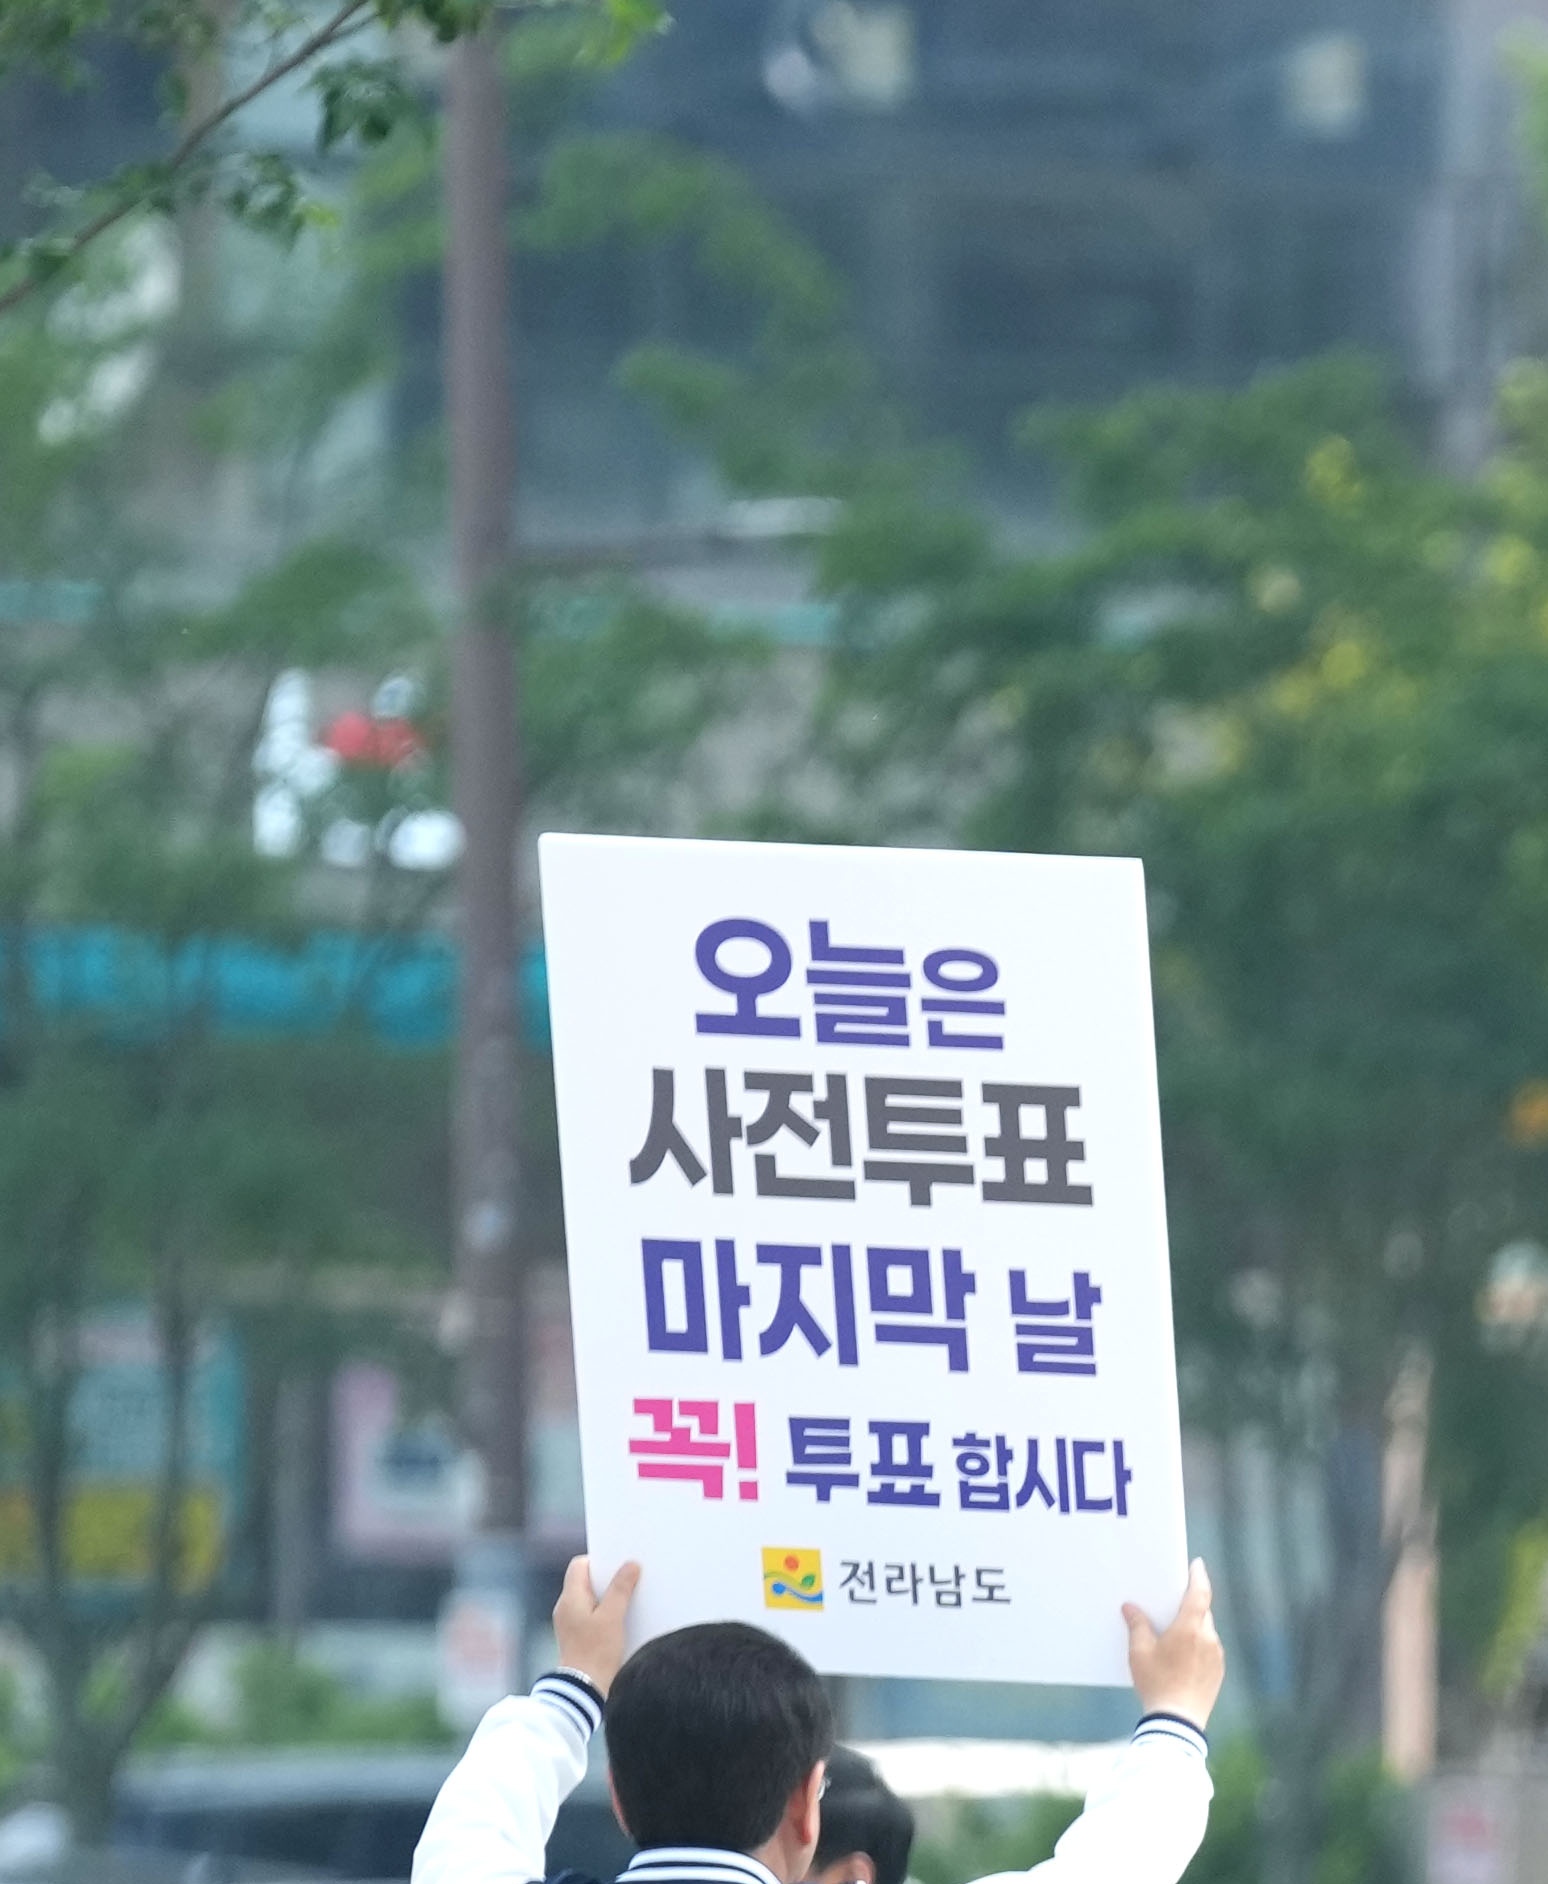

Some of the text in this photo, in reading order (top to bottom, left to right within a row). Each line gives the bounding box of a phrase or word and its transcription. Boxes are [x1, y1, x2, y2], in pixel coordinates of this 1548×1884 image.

[695, 917, 1006, 1050] 오늘은
[629, 1066, 1094, 1207] 사전투표
[641, 1238, 1103, 1377] 마지막 날
[629, 1397, 1133, 1517] 꼭! 투표 합시다
[839, 1559, 1012, 1606] 전라남도
